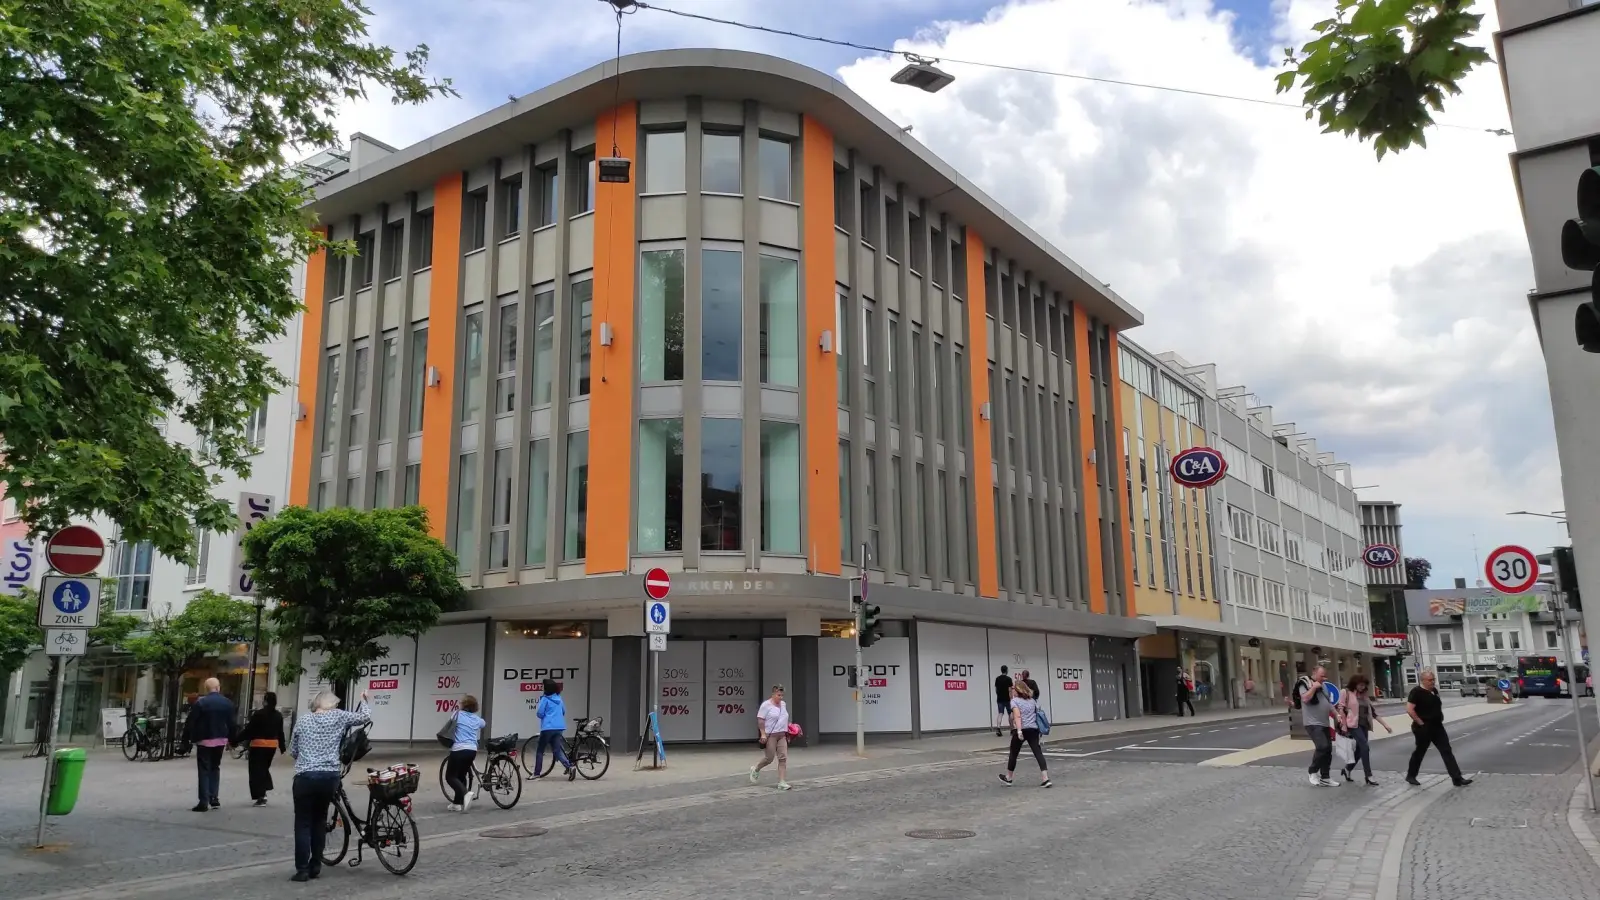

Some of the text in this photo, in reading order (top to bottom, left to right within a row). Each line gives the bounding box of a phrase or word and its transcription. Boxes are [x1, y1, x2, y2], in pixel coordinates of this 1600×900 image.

[1180, 456, 1216, 476] C&A
[1369, 550, 1392, 562] C&A
[1496, 558, 1527, 581] 30
[55, 615, 84, 624] ZONE
[440, 652, 461, 666] 30%
[360, 663, 410, 678] DEPOT
[504, 667, 580, 680] DEPOT
[663, 668, 689, 679] 30%
[718, 668, 744, 679] 30%
[935, 663, 974, 676] DEPOT
[1056, 668, 1084, 679] DEPOT
[372, 681, 396, 689] OUTLET
[437, 676, 460, 689] 50%
[947, 681, 966, 689] OUTLET
[662, 687, 689, 697] 50%
[718, 686, 745, 696] 50%
[436, 700, 460, 713] 70%
[661, 704, 690, 715] 70%
[717, 703, 745, 714] 70%
